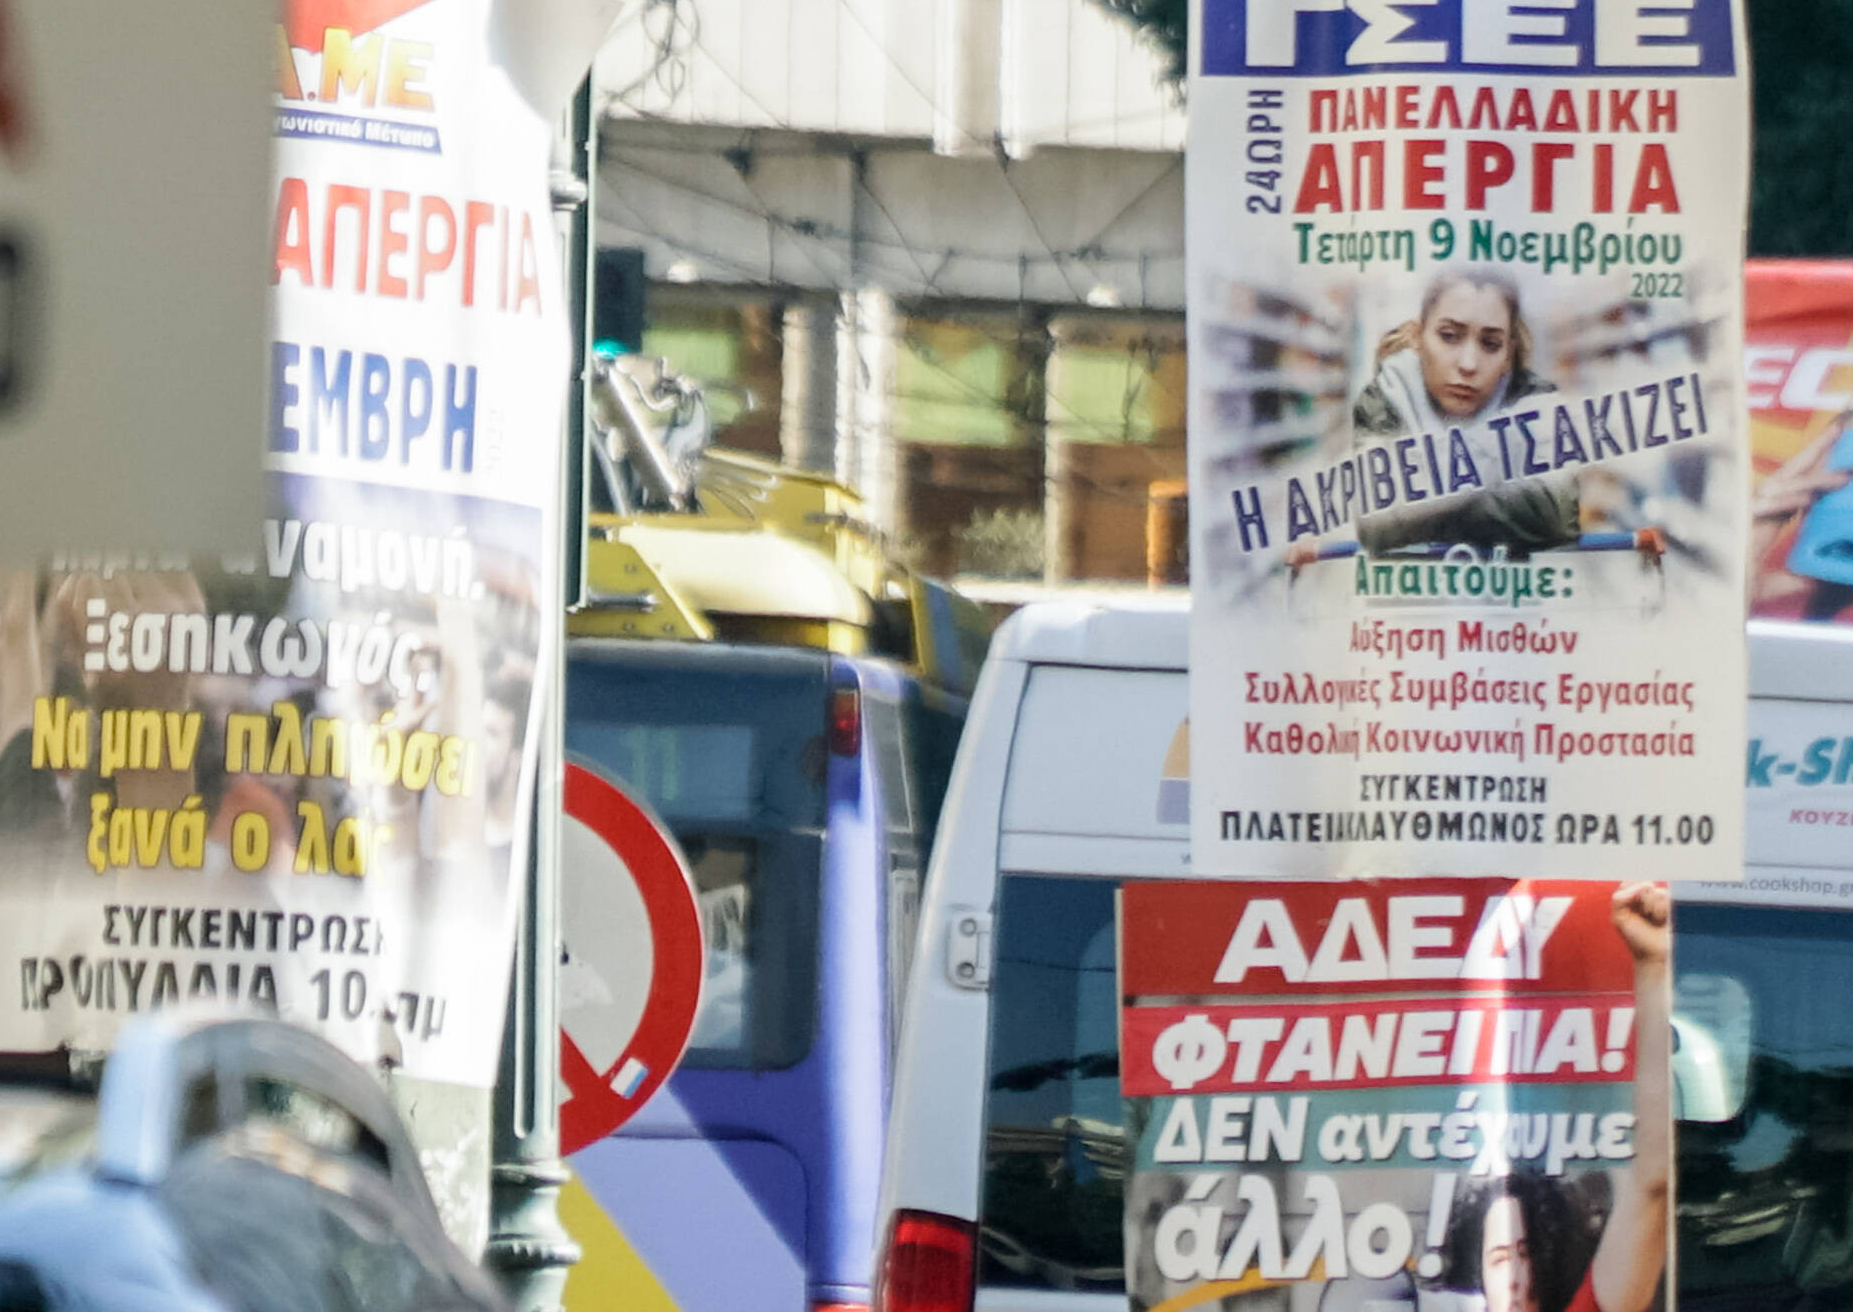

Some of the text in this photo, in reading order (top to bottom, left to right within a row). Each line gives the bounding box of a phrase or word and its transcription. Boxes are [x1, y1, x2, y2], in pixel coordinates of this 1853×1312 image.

[1307, 84, 1679, 134] ΠΑΝΕΛΛΑΔΙΚΗ
[1292, 139, 1682, 215] ΑΠΕΡΓΙΑ
[272, 175, 543, 318] ΑΠΕΡΓΙΑ
[1292, 215, 1683, 275] Τετάρτη 9 Νοεμβρίου
[1631, 272, 1684, 299] 2022
[1231, 371, 1710, 553] Η ΑΚΡΙΒΕΙΑ ΤΣΑΚΙΖΕΙ
[1354, 546, 1575, 607] Απαιτούμε:
[1457, 617, 1578, 656] Μισθών
[1389, 669, 1549, 712] Συμβάσεις
[1557, 669, 1696, 713] Εργασίας
[31, 695, 89, 770] Να
[100, 705, 203, 777] μην
[1365, 718, 1525, 762] Κοινωνική
[1534, 719, 1696, 762] Προστασία
[1359, 774, 1548, 804] ΣΥΓΚΕΝΤΡΩΣΗ
[86, 791, 206, 875] ξανά
[231, 810, 270, 872] ο
[1555, 813, 1621, 846] ΩΡΑ
[1631, 814, 1716, 846] 11.00
[1213, 893, 1575, 984] ΑΔΕΔΥ
[1151, 1007, 1484, 1090] ΦΤΑΝΕΙ
[1152, 1095, 1311, 1164] ΔΕΝ
[1152, 1171, 1457, 1281] άλλο!
